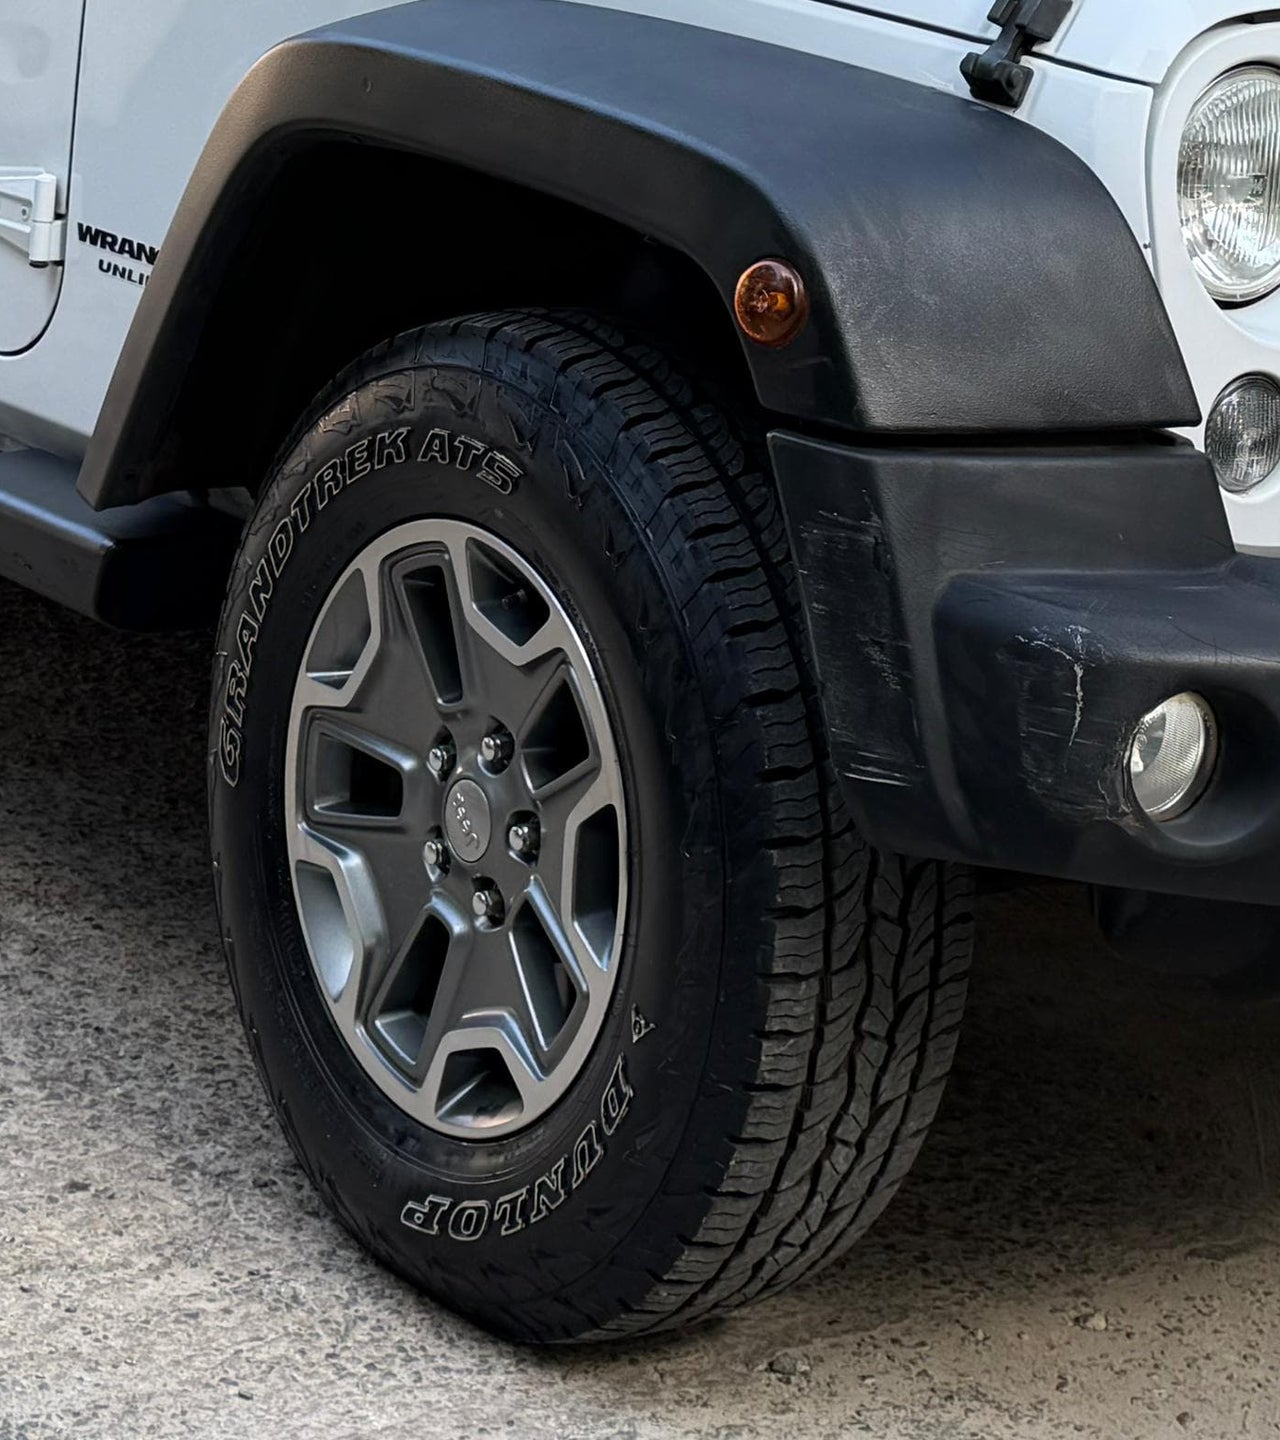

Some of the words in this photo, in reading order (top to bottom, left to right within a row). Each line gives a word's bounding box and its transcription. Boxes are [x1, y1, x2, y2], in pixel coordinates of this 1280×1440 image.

[77, 222, 160, 266] WRAN
[98, 258, 150, 286] UNLI
[220, 426, 412, 787] GRANDTREK
[400, 1054, 634, 1241] DUNLOP
